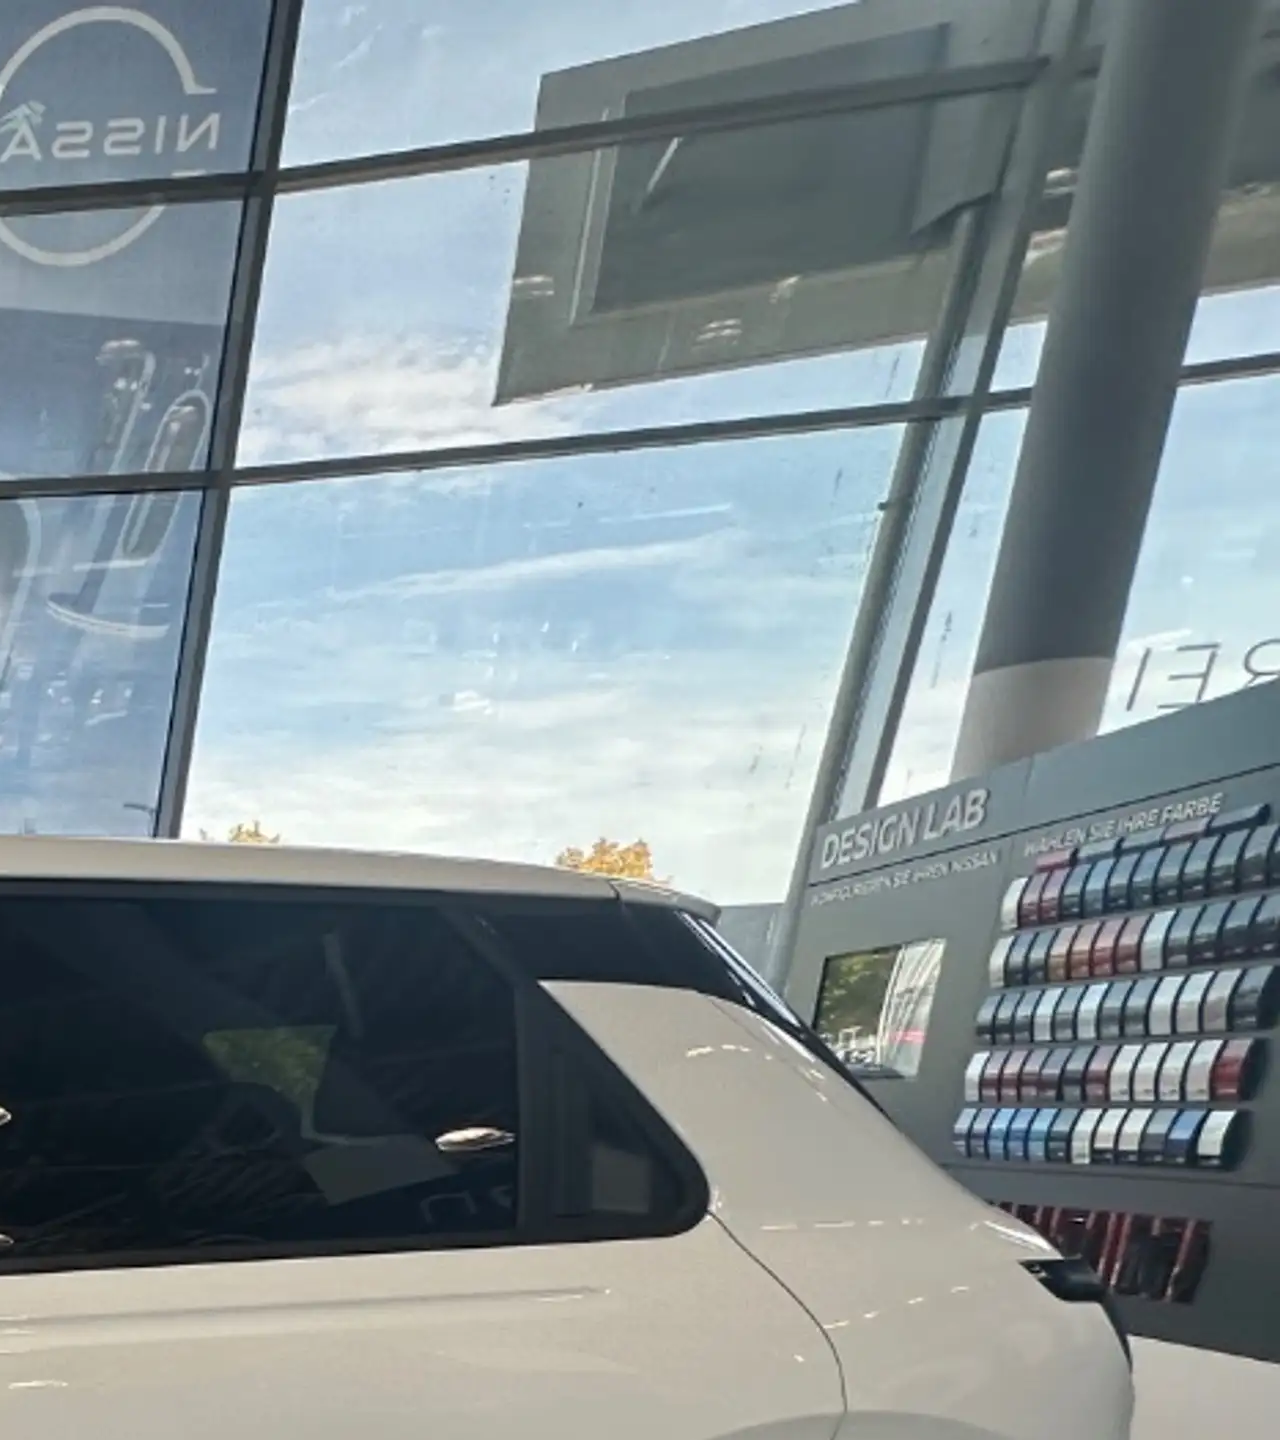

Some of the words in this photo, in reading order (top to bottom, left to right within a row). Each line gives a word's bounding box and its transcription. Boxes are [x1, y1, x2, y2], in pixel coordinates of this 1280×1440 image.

[820, 812, 924, 869] DESIGN
[925, 788, 991, 842] LAB
[1159, 792, 1224, 827] FARBE
